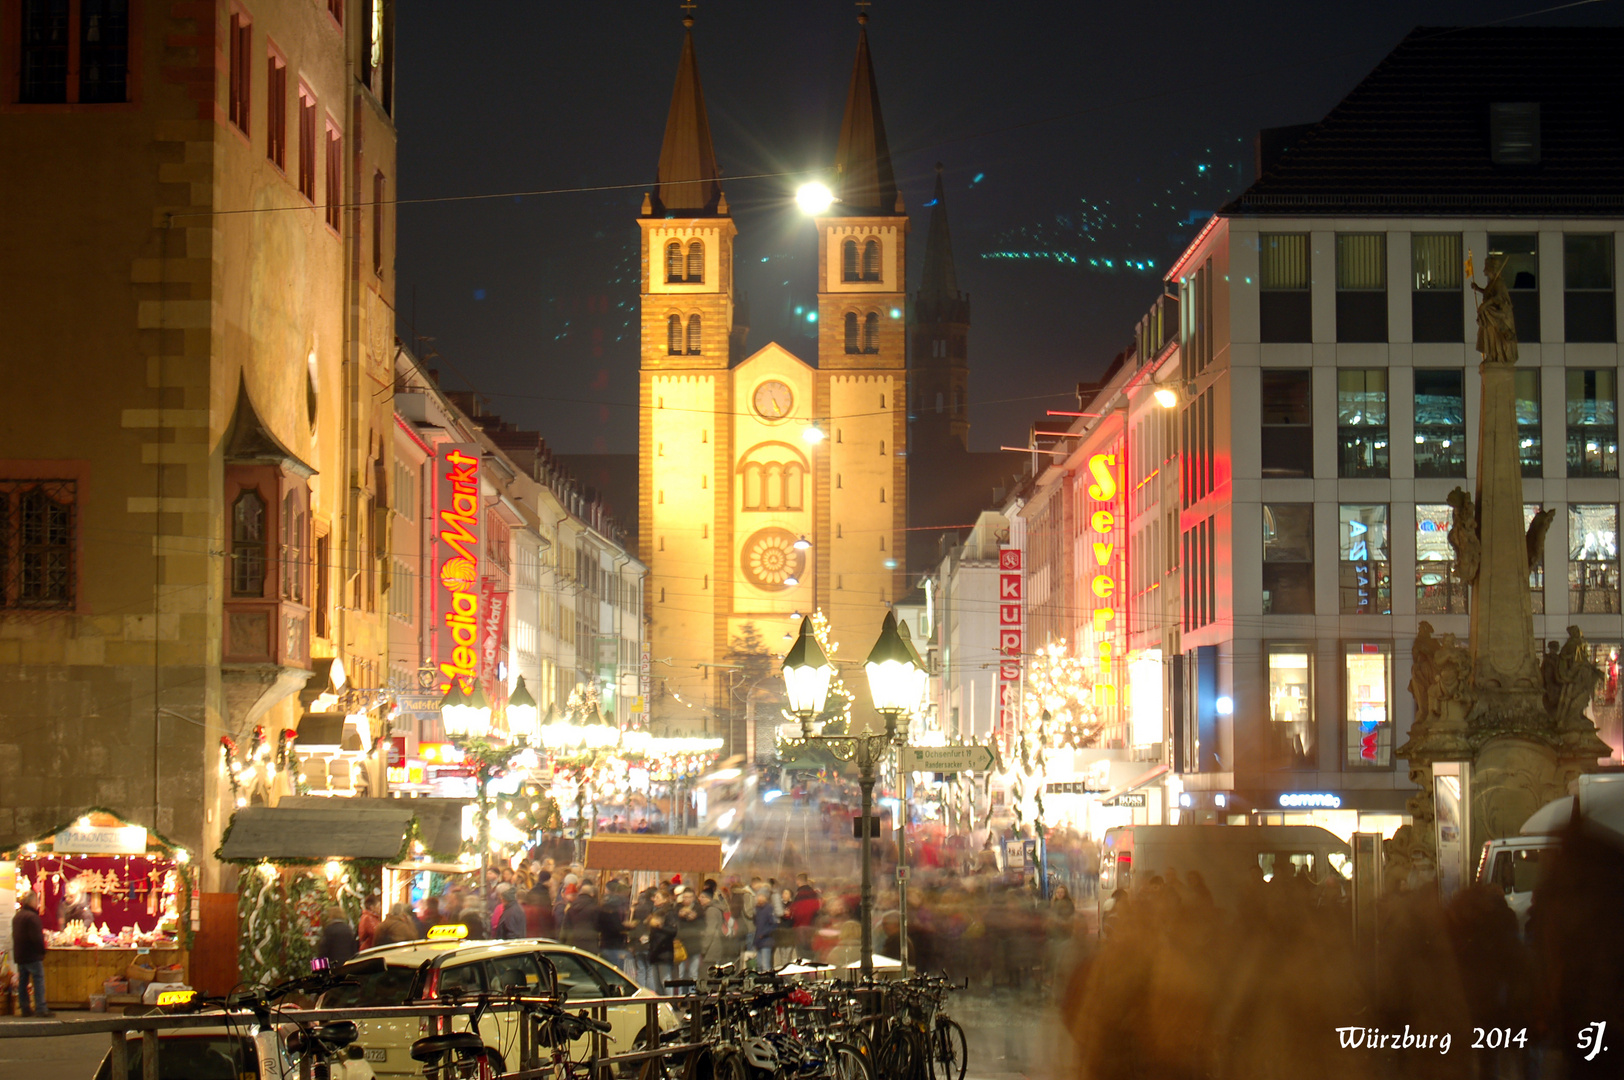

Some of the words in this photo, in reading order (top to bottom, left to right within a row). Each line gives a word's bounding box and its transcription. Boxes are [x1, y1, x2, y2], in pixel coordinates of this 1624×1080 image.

[439, 449, 479, 566] Markt
[1088, 454, 1117, 706] Severin
[440, 591, 479, 697] Media
[640, 653, 650, 728] APOTHEK
[924, 750, 965, 758] Ochsenfurt
[924, 761, 963, 769] Randersacker
